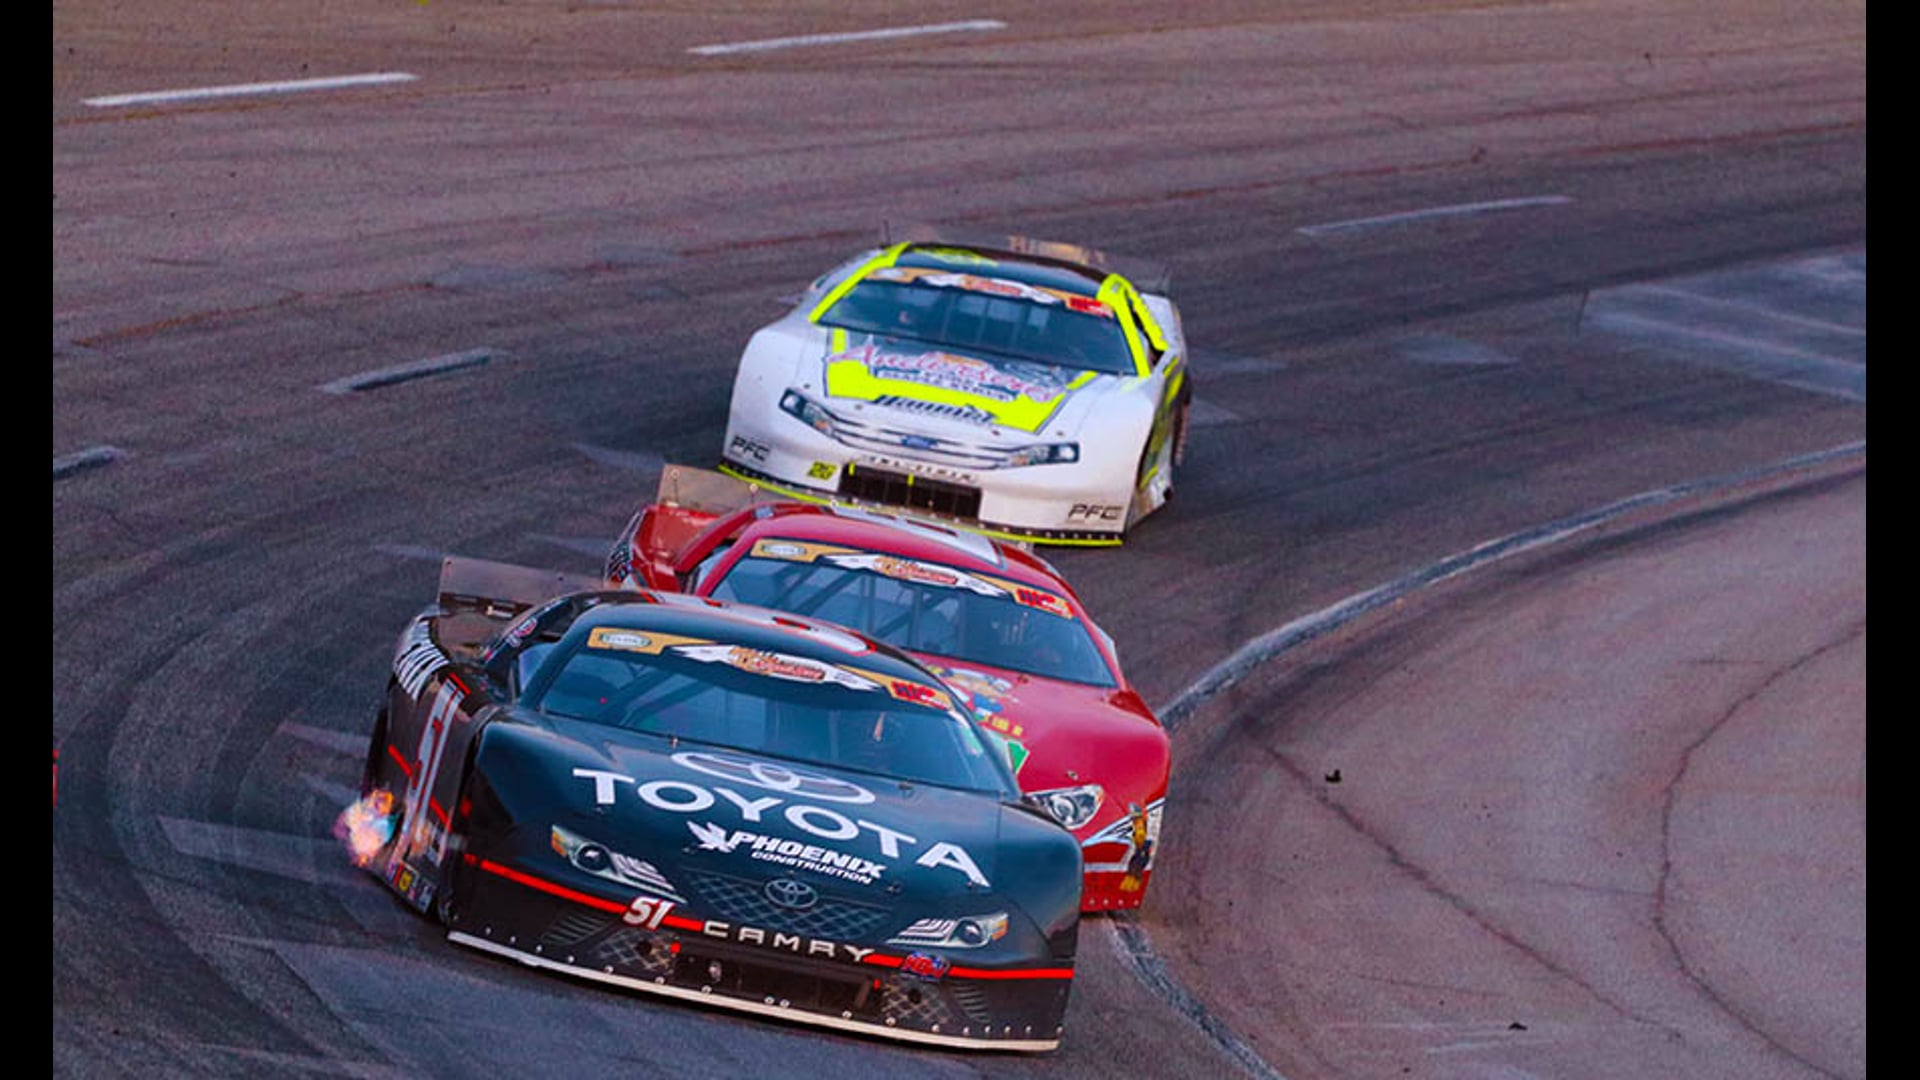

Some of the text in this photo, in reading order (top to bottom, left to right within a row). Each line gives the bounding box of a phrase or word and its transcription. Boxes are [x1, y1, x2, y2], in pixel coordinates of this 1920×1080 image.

[731, 436, 769, 461] PFC
[1067, 503, 1124, 520] PFC
[573, 769, 990, 887] TOYOTA
[729, 831, 887, 878] PHOENIX
[751, 851, 872, 885] CONSTRUCTION
[623, 896, 675, 930] 51
[703, 920, 875, 963] CAMRY
